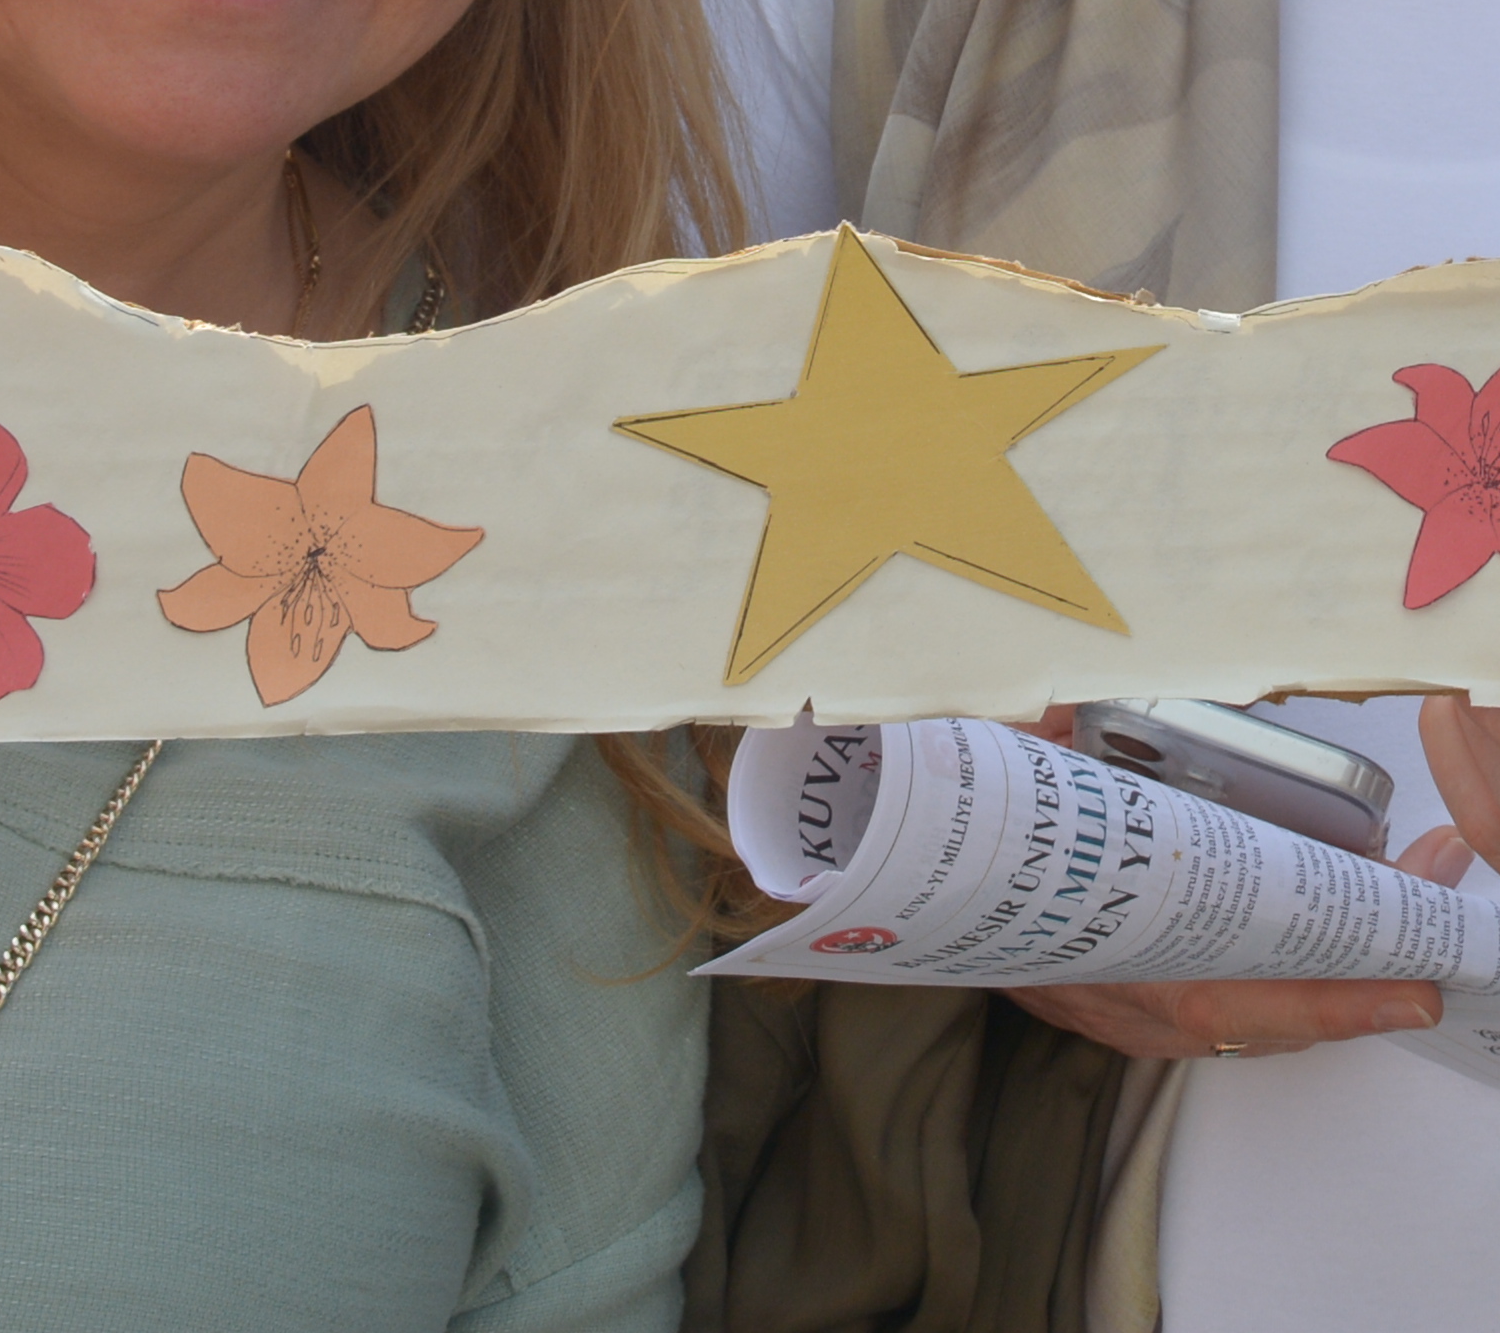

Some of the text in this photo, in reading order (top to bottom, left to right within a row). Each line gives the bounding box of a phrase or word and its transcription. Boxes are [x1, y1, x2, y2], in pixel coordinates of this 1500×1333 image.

[894, 715, 974, 919] KUVA-YI MİLLİYE MECMUAS
[1183, 866, 1215, 931] programla
[1184, 855, 1201, 906] kurulan
[1203, 881, 1227, 930] merkezi
[1222, 859, 1231, 874] ve
[1214, 852, 1252, 937] açıklamasıyla
[1239, 875, 1261, 930] neferleri
[1252, 845, 1264, 869] için
[1270, 842, 1307, 954] yürüten Balıkesir
[891, 901, 1027, 968] BALIKESİR
[1285, 917, 1314, 954] Serkan
[1315, 869, 1350, 963] öğretmenlerinin
[1361, 910, 1379, 956] gençlik
[1403, 902, 1423, 960] Balıkesir
[1438, 919, 1451, 957] Selim
